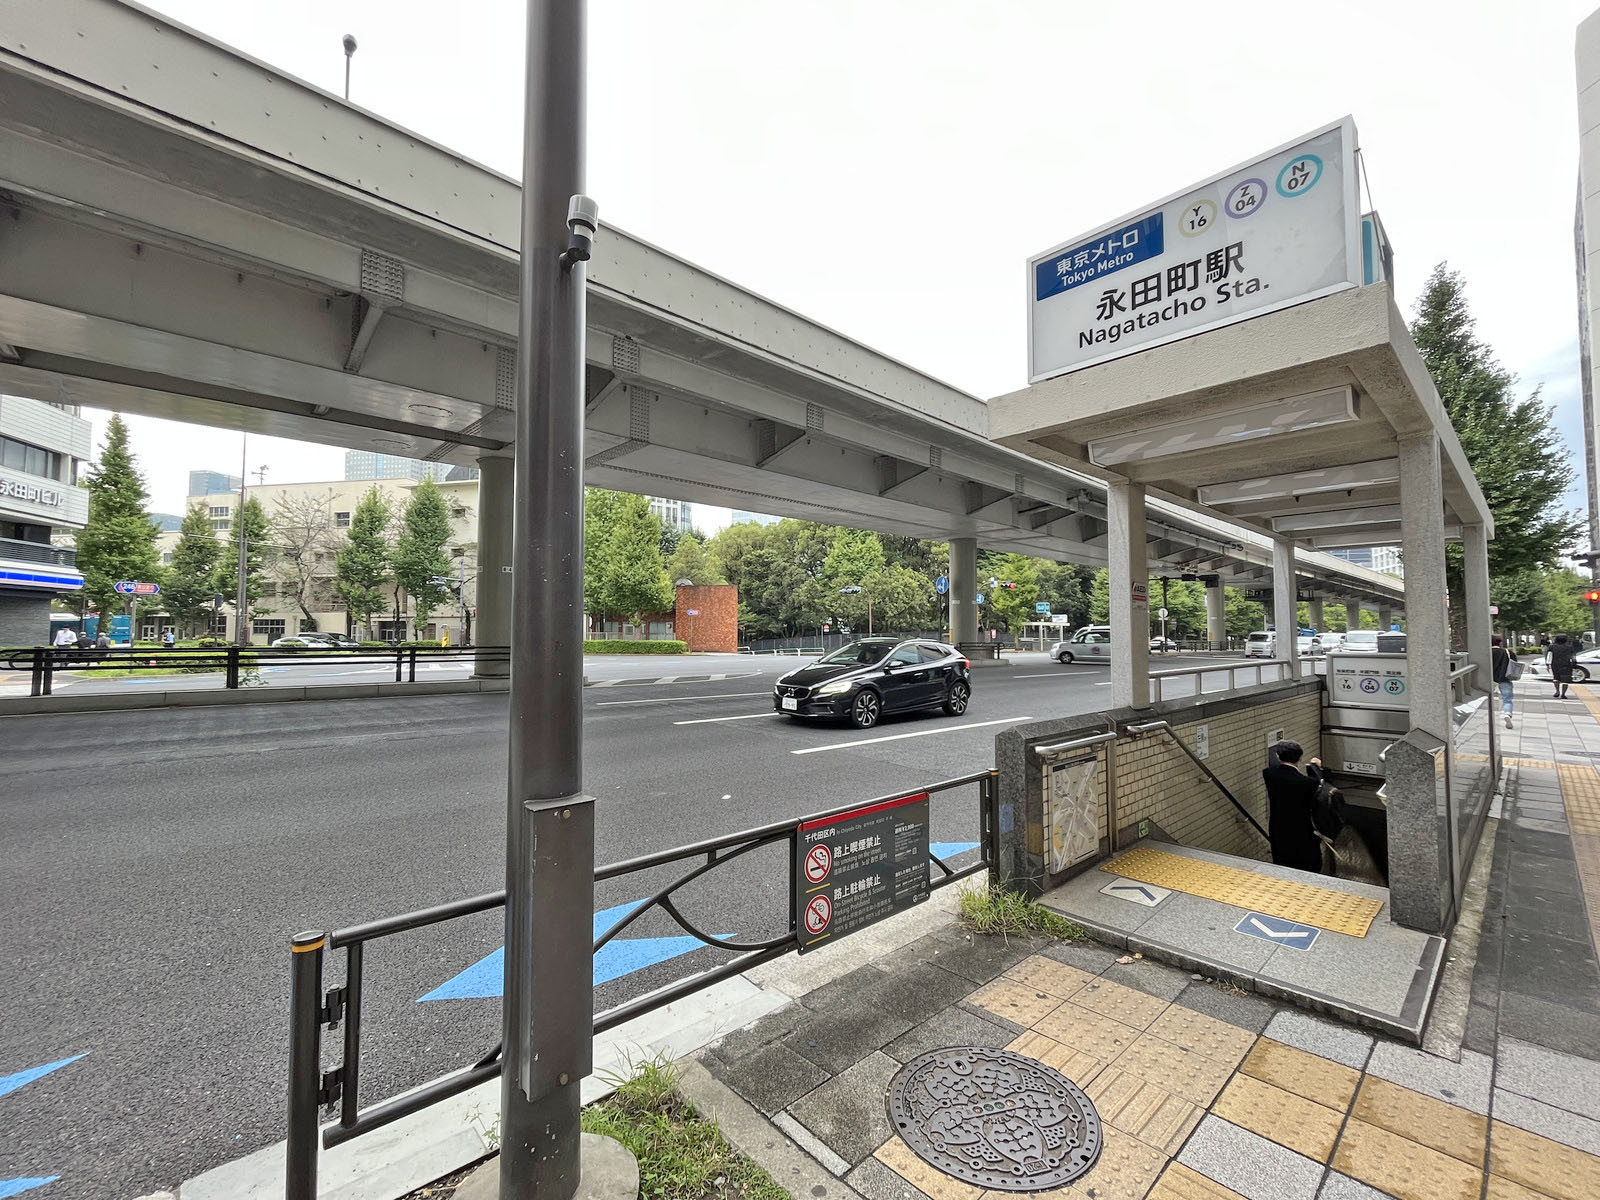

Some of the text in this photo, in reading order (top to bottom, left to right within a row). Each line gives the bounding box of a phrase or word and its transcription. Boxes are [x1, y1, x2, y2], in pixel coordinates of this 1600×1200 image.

[1292, 162, 1306, 176] N
[1240, 185, 1251, 198] Z
[1287, 173, 1310, 190] 07
[1191, 205, 1202, 217] Y
[1235, 195, 1257, 212] 04
[1189, 215, 1207, 231] 16
[1056, 229, 1139, 277] 東京メトロ
[1061, 250, 1134, 287] Tokyo Metro
[1096, 240, 1245, 322] 永田町駅
[1078, 276, 1271, 350] Nagatacho Sta.
[0, 479, 65, 507] 永田町ビル
[804, 828, 836, 844] 千代田区内
[834, 834, 882, 858] 路上喫煙禁止
[834, 874, 881, 900] 路上駐輪禁止
